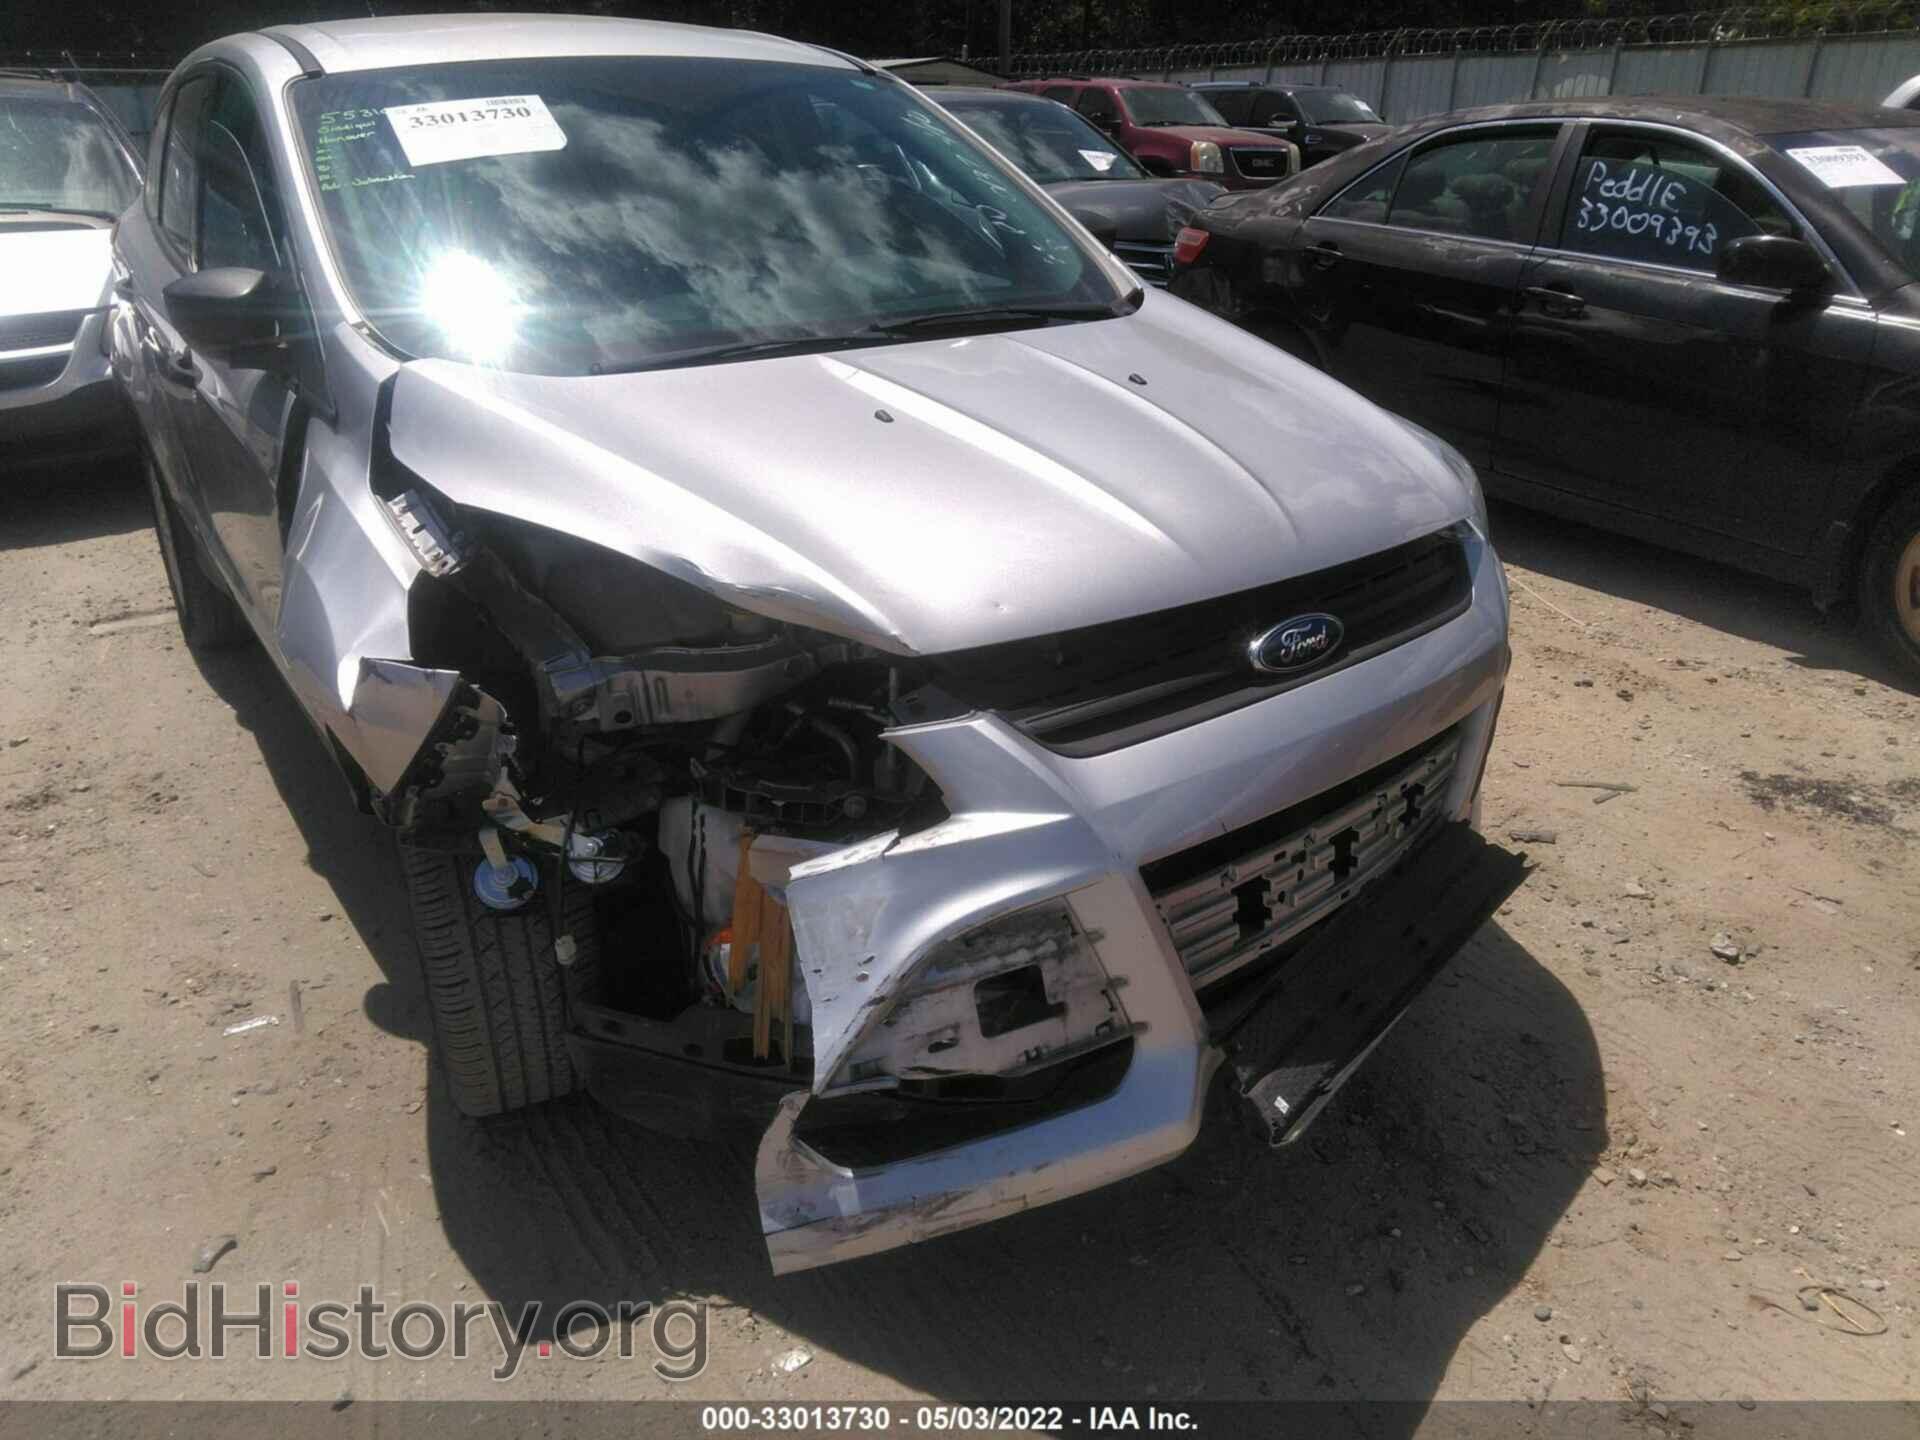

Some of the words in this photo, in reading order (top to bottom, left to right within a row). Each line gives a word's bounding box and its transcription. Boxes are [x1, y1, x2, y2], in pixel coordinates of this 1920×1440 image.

[409, 107, 531, 129] 33013730
[1577, 196, 1718, 255] 33009393
[1280, 623, 1328, 663] Ford
